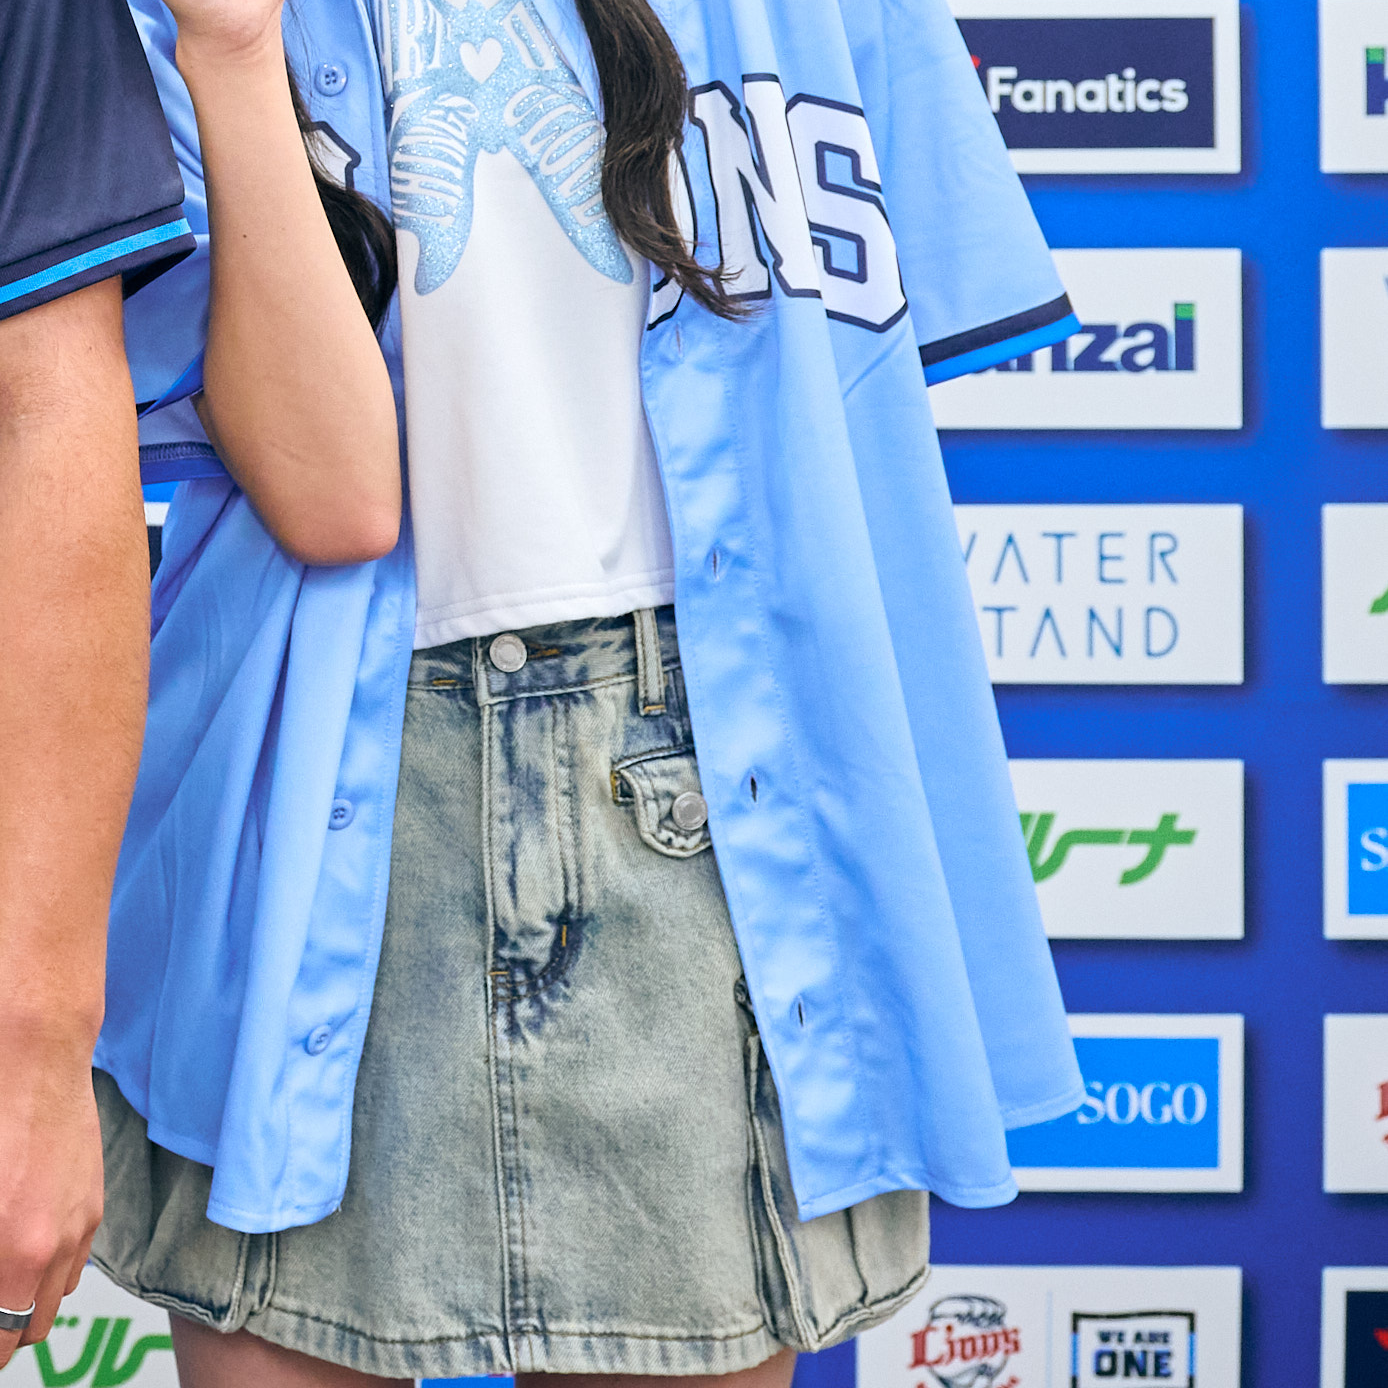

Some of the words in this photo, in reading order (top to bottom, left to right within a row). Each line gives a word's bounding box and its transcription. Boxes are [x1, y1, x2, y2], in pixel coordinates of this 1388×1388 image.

[988, 67, 1189, 113] Fanatics
[968, 533, 1179, 585] ATER
[982, 607, 1179, 659] TAND
[1020, 812, 1197, 885] ルーナ
[1077, 1081, 1207, 1124] SOGO
[909, 1323, 1021, 1370] Lions
[1098, 1331, 1124, 1344] WE
[1133, 1331, 1169, 1345] ARE
[1095, 1350, 1172, 1378] ONE
